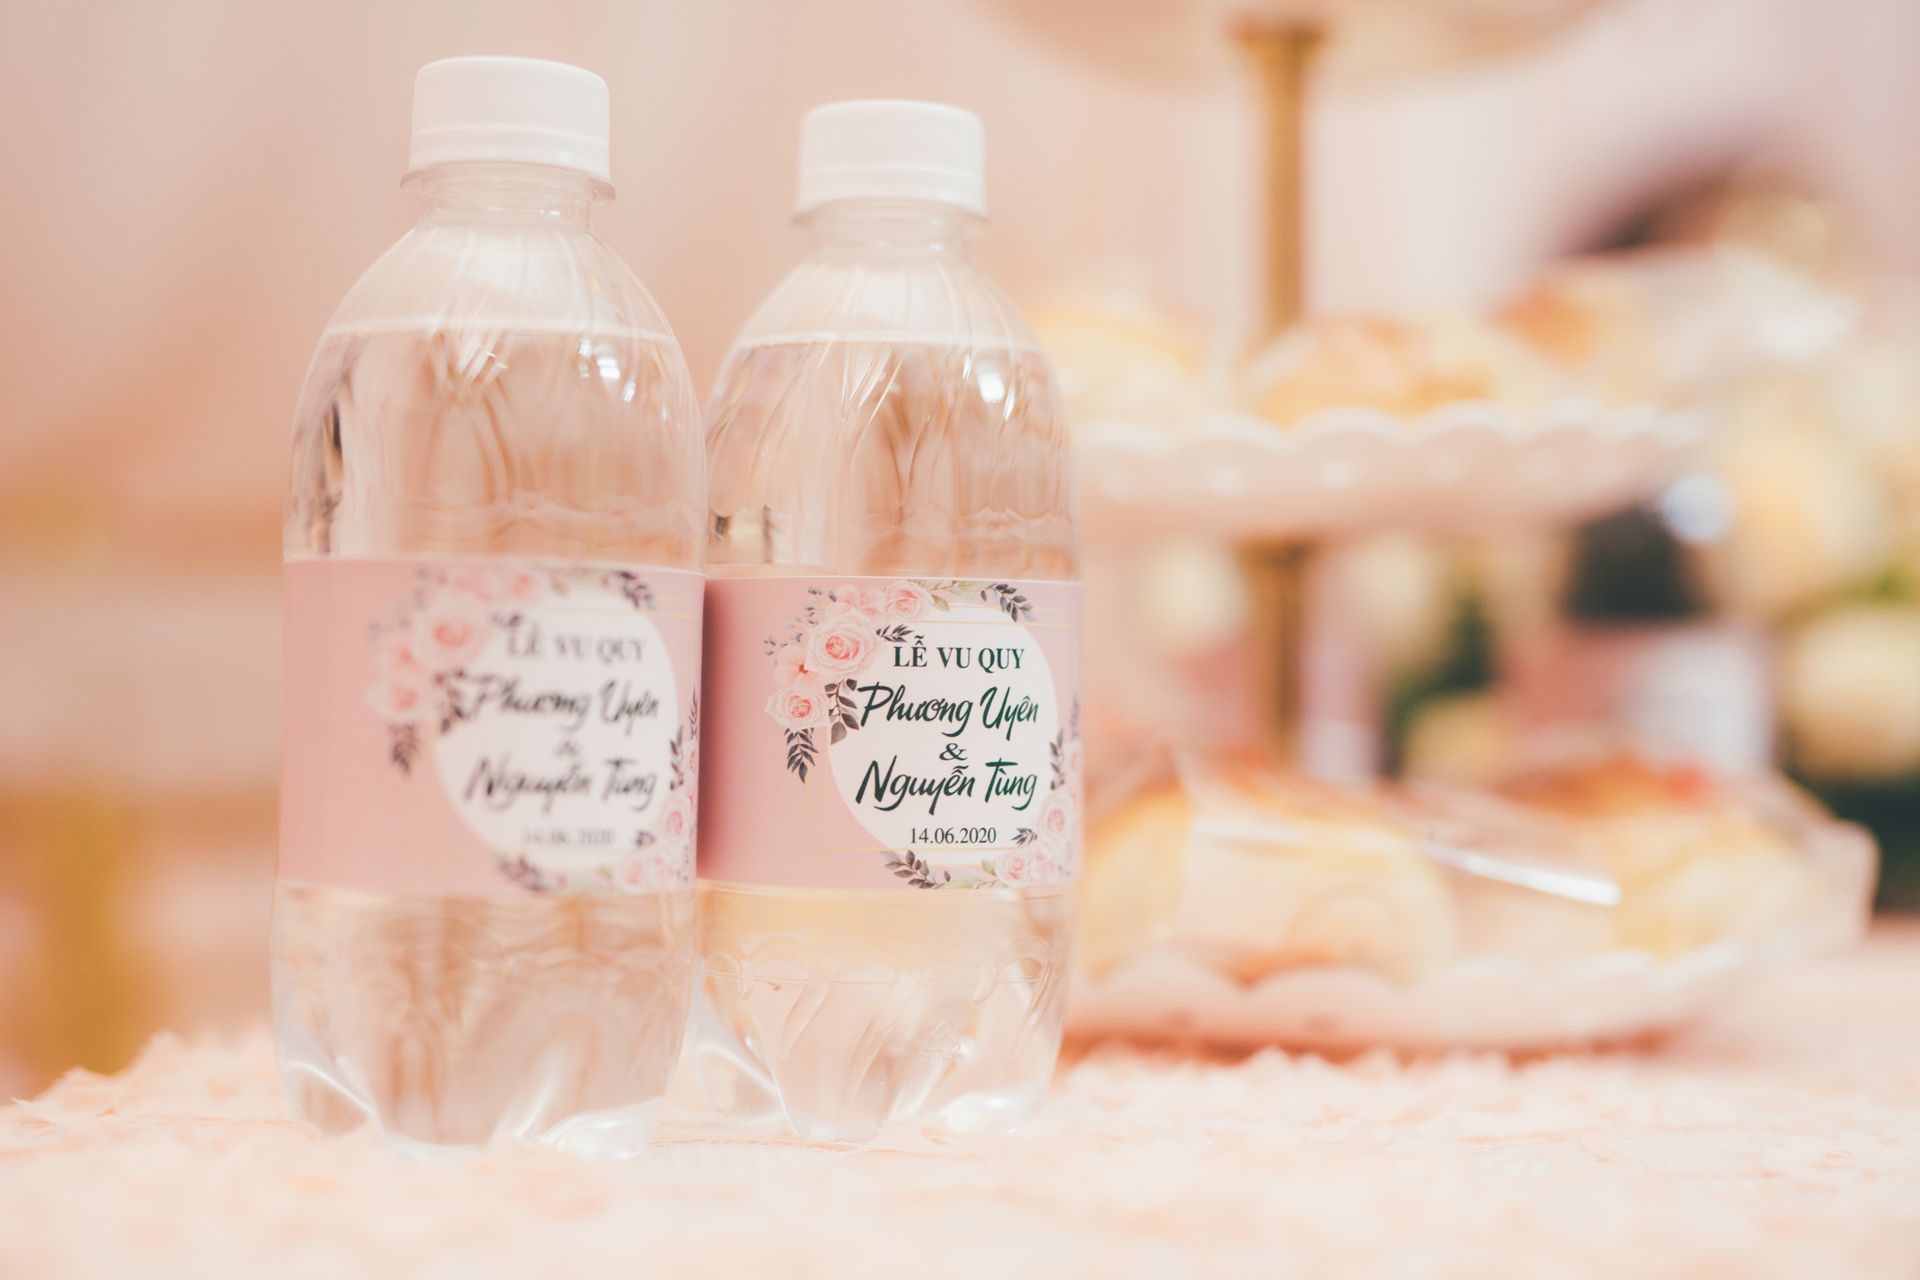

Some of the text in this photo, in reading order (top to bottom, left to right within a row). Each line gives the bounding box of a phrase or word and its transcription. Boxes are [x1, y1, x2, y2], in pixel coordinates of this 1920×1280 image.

[893, 635, 1025, 674] LỄ VU QUY
[856, 681, 1039, 741] Phương Uyên
[939, 742, 968, 761] &
[855, 754, 1037, 816] Nguyễn Tùng
[910, 827, 997, 845] 14.06.2020
